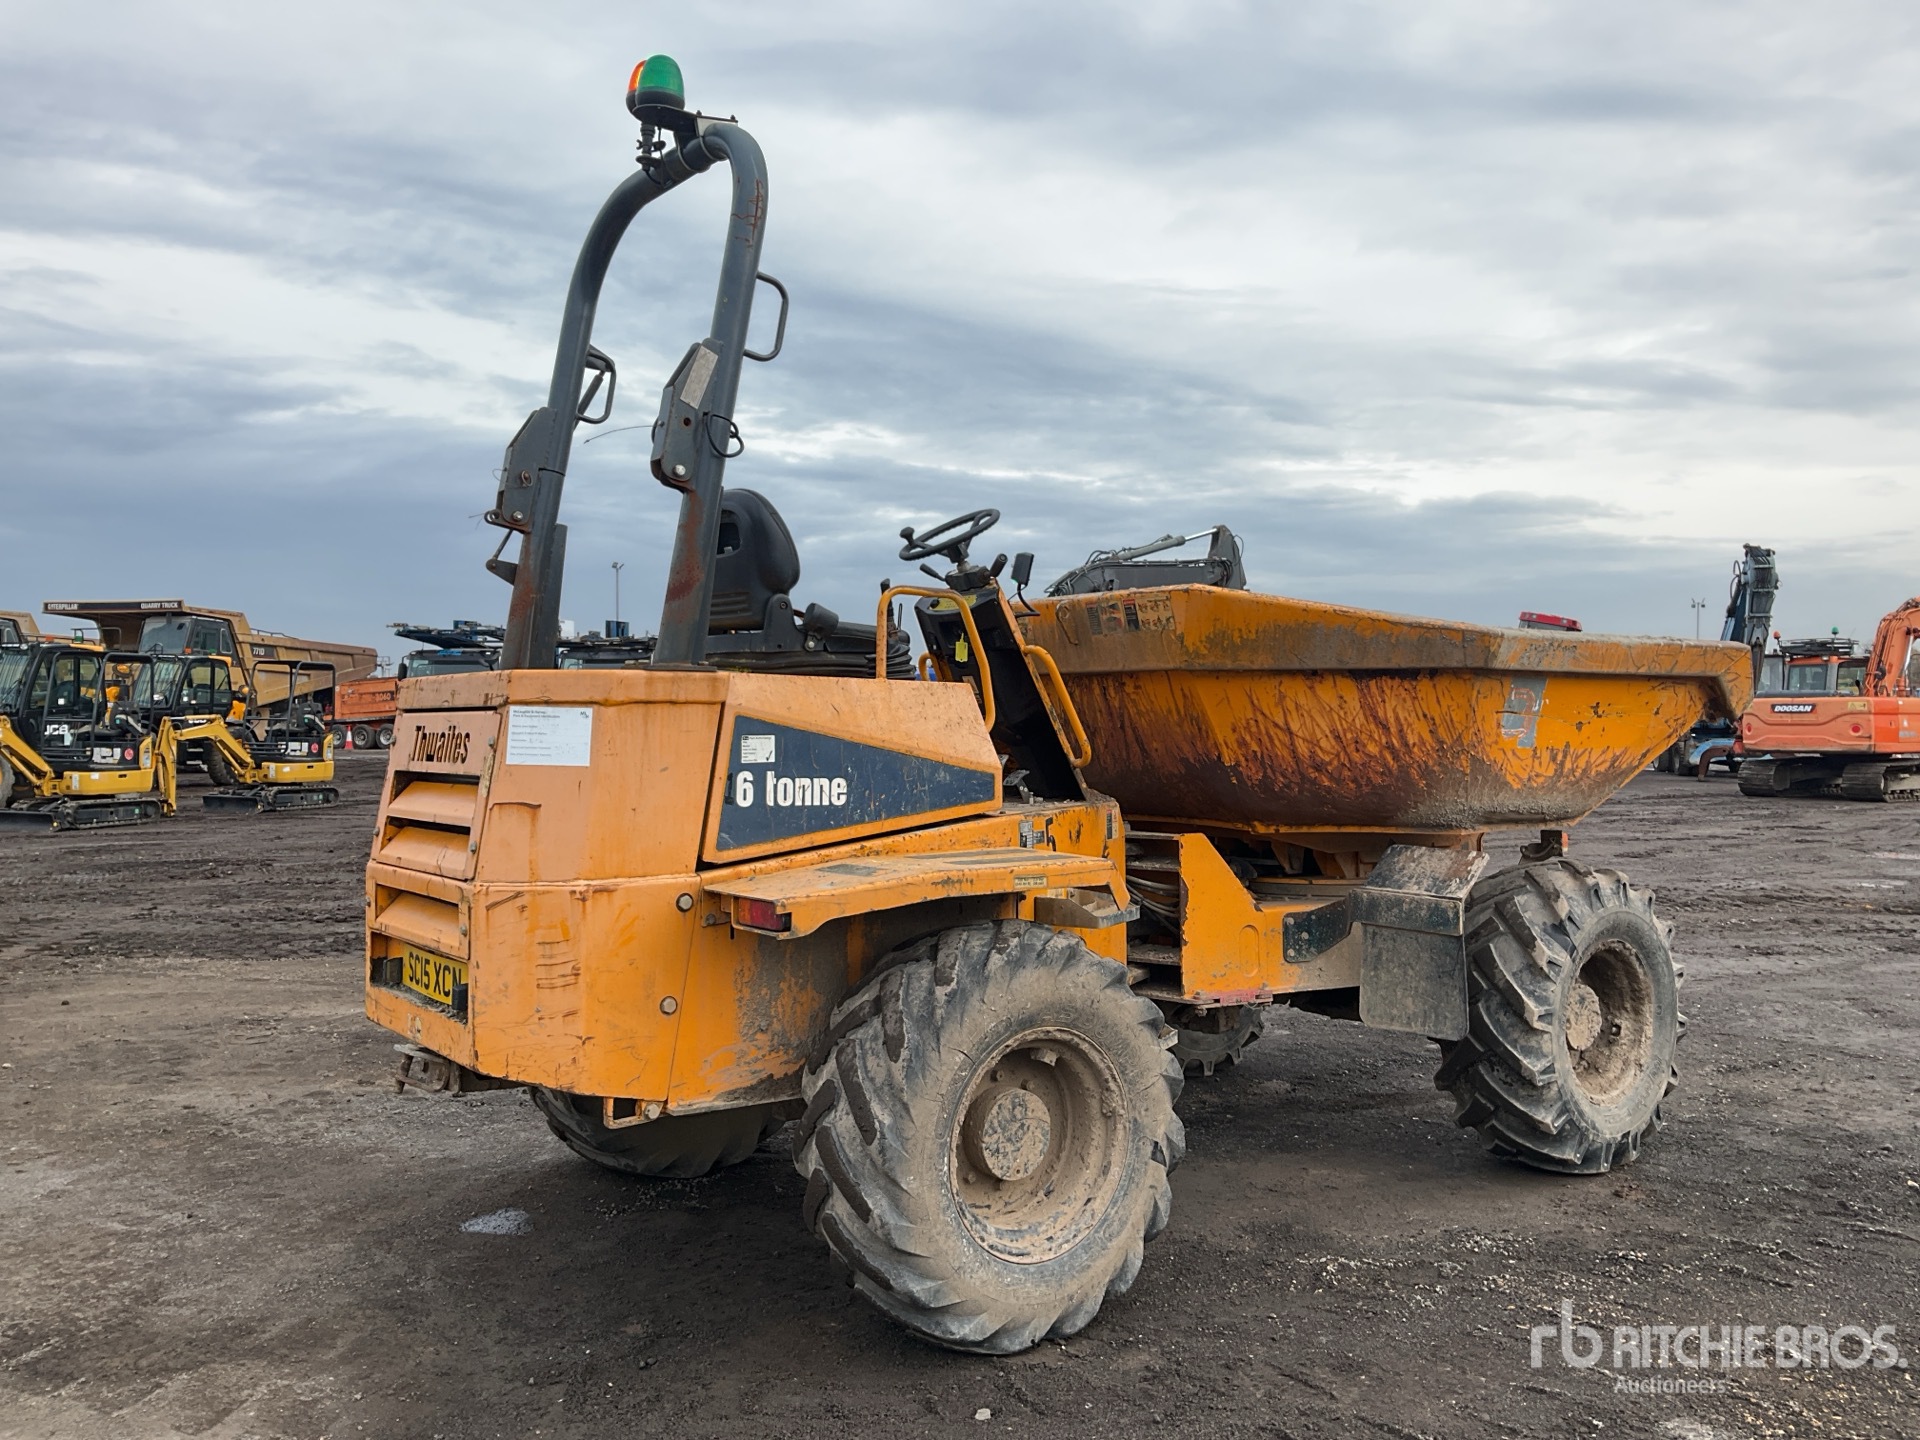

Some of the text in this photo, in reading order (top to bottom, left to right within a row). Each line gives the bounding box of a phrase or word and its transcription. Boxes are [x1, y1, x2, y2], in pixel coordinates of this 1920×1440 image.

[141, 602, 161, 610] QUARRY
[44, 724, 69, 735] JCB
[411, 725, 471, 764] Thwaites
[736, 770, 848, 808] 6 tonne
[408, 951, 431, 990] SC15
